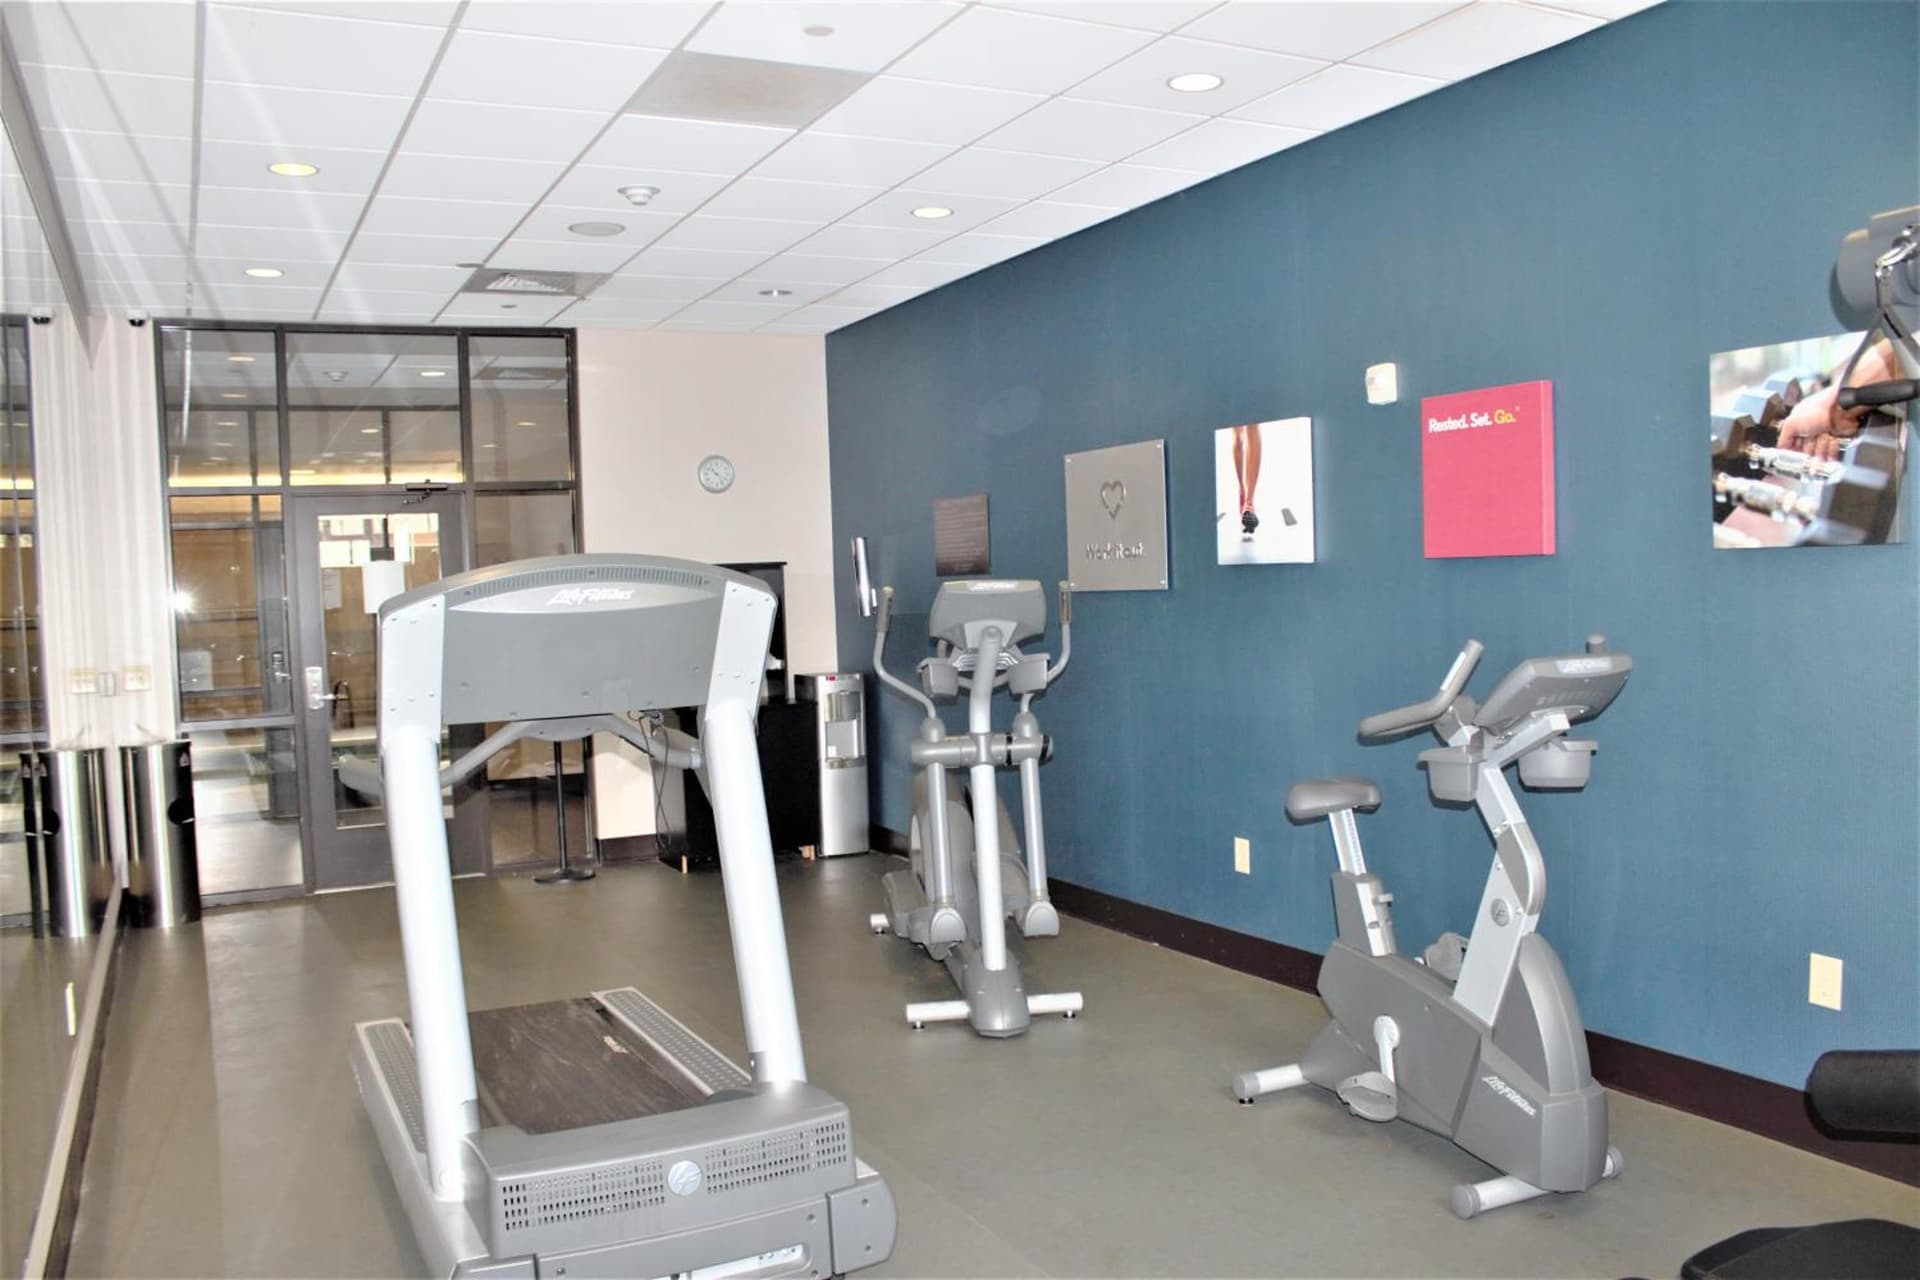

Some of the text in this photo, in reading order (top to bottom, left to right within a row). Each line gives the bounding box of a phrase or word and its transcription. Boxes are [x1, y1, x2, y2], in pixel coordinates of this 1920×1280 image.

[1428, 408, 1516, 433] Rested. Set. Go.
